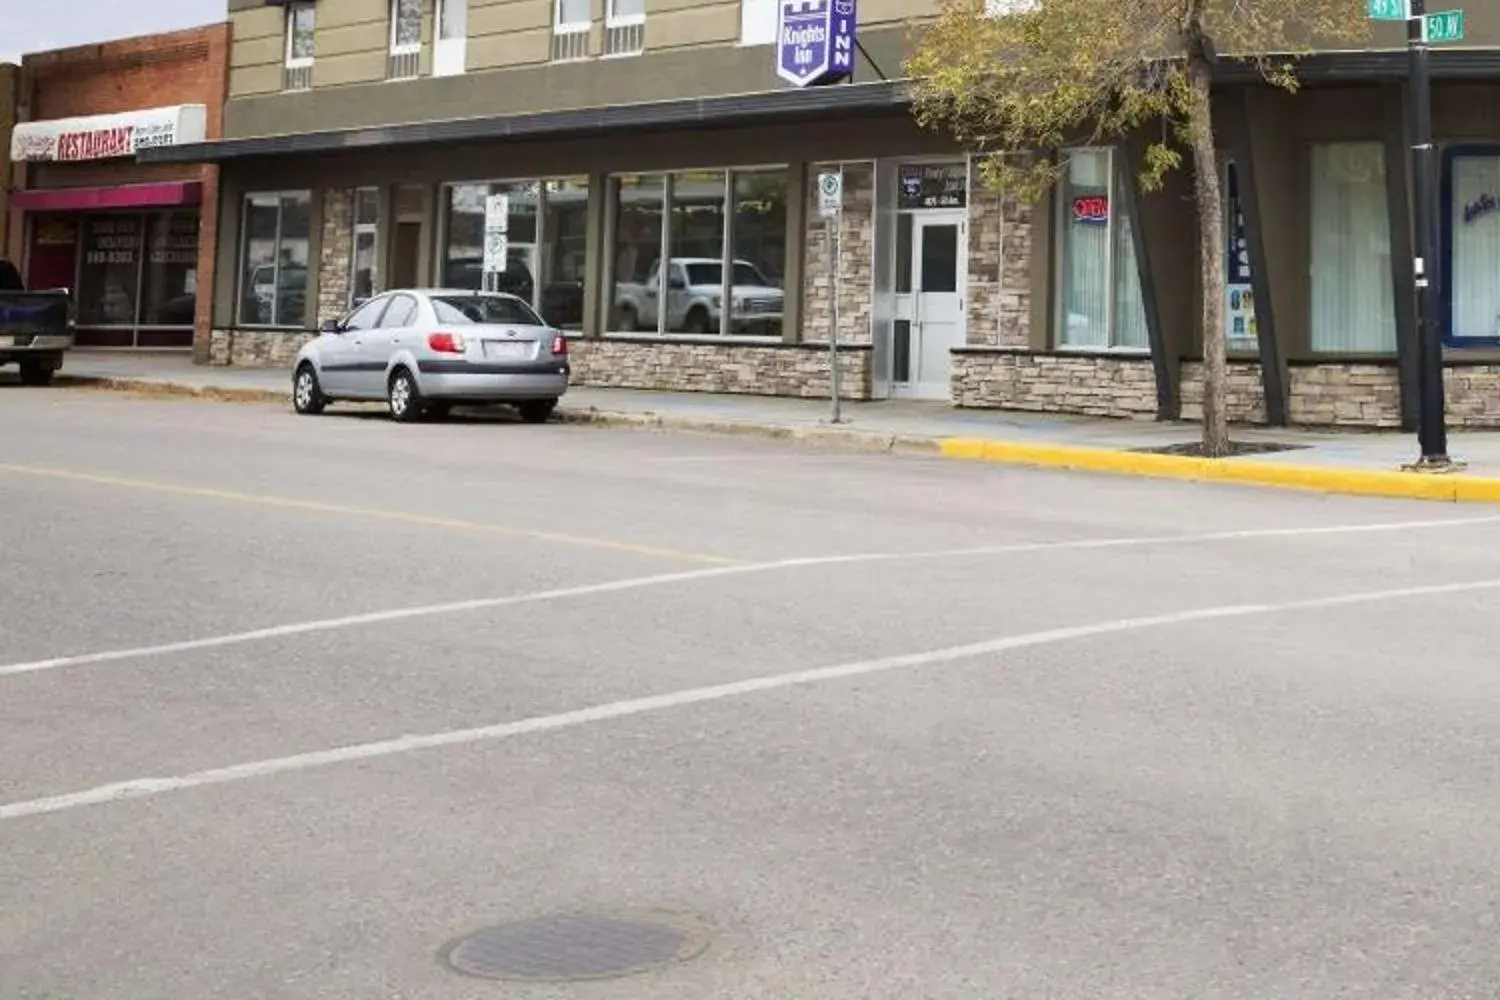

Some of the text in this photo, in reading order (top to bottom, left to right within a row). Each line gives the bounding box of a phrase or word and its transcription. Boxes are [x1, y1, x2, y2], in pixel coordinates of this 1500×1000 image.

[783, 23, 825, 48] Knights
[1427, 16, 1443, 40] 50
[794, 45, 813, 65] Inn
[834, 19, 851, 67] INN
[56, 124, 134, 159] RESTAURANT
